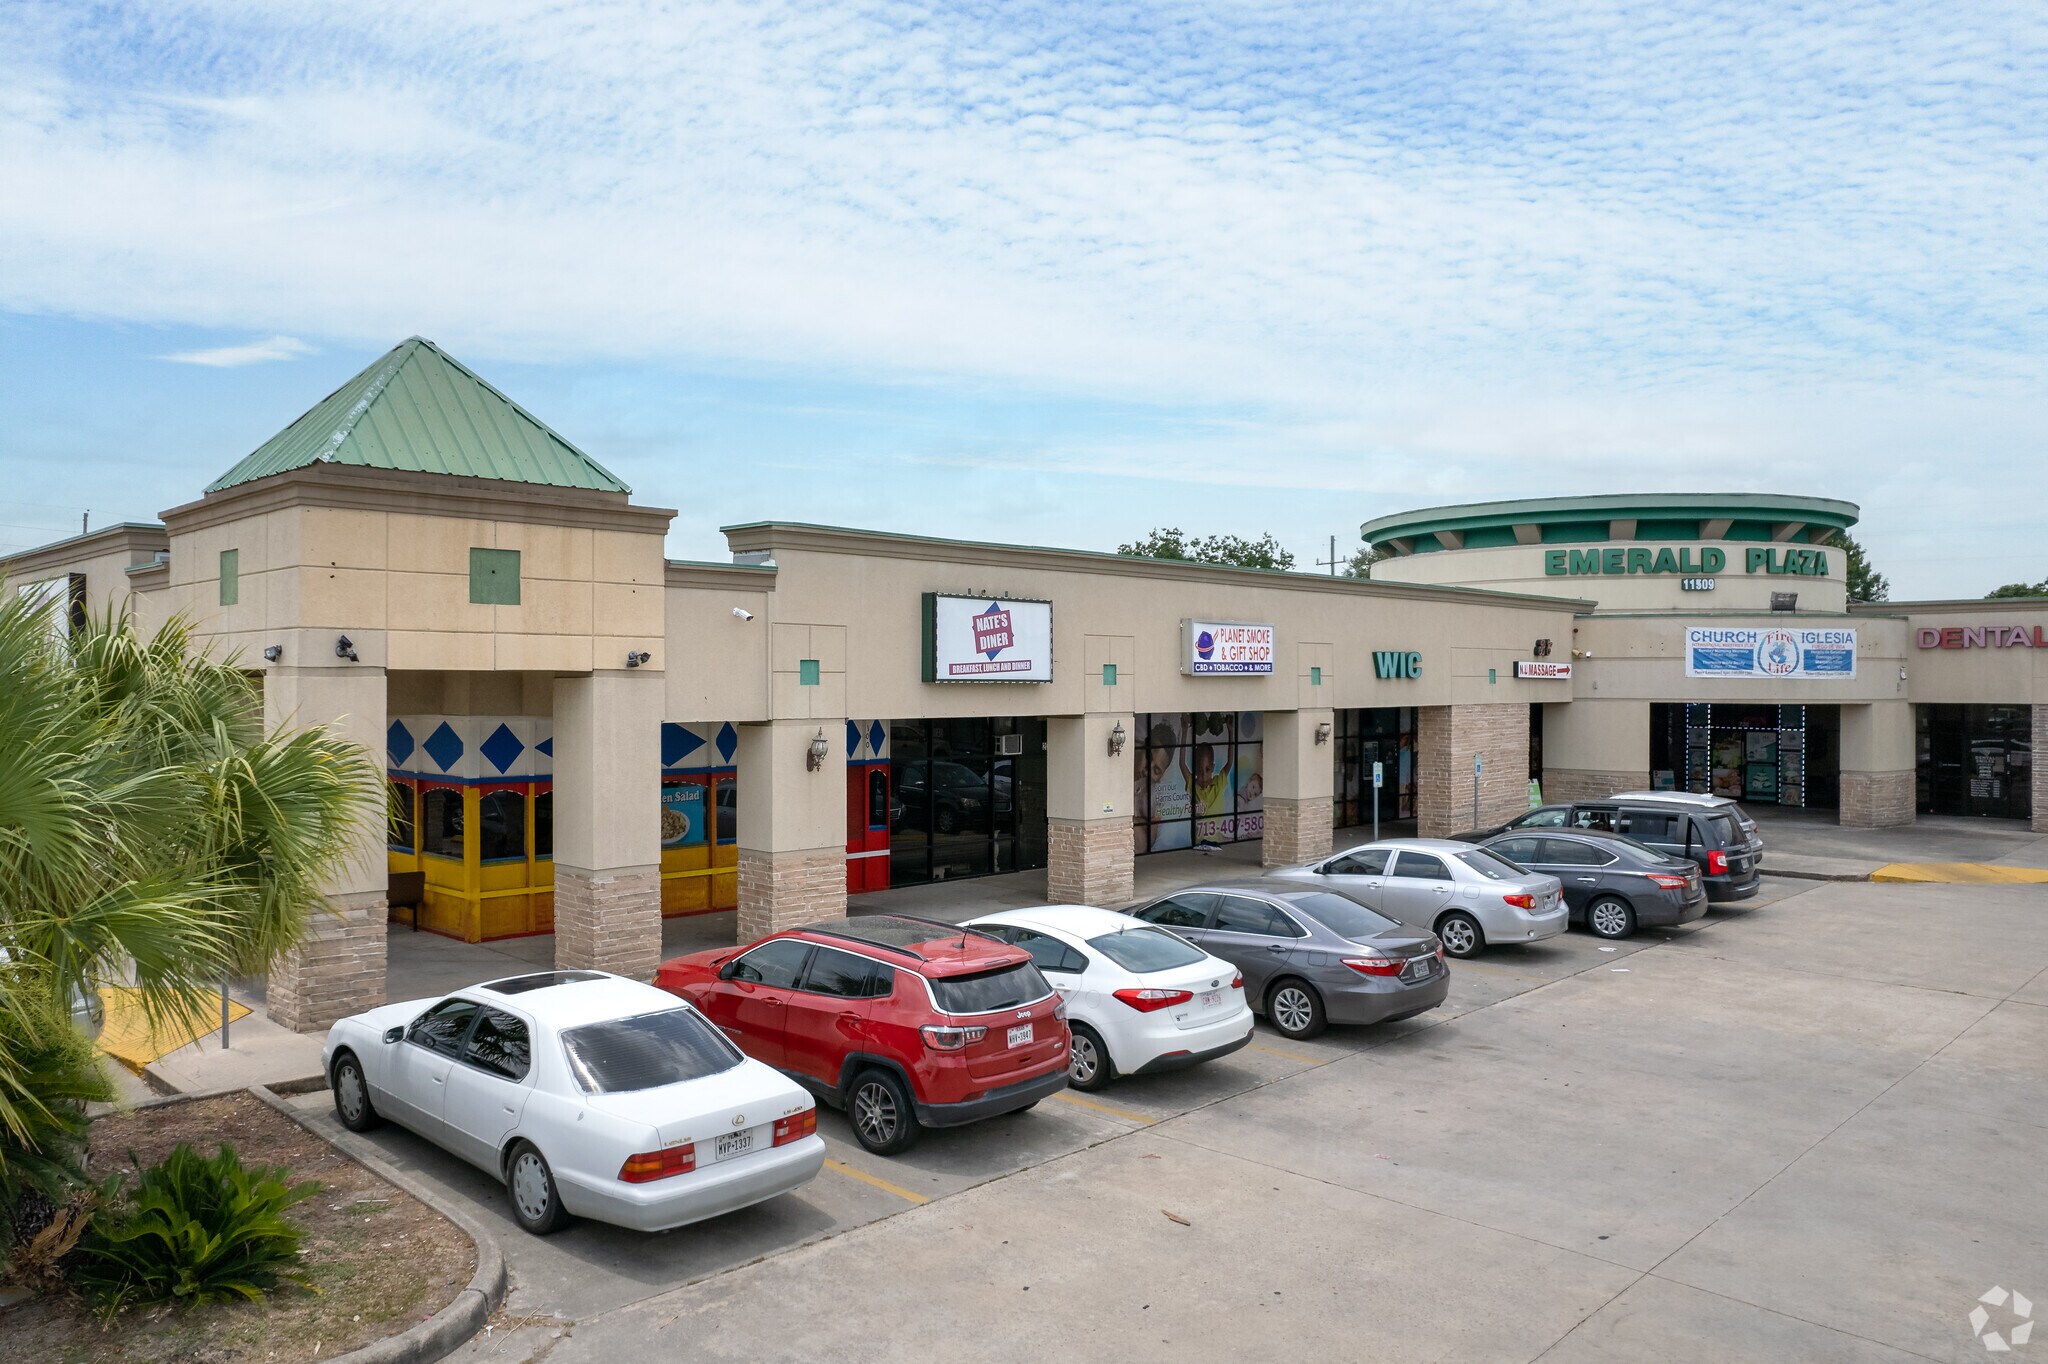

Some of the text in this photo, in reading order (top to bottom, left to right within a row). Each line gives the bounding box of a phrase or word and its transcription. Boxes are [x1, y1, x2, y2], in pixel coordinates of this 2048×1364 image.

[1545, 547, 1829, 576] EMERALD PLAZA
[976, 614, 1008, 632] NATE'S
[980, 632, 1008, 650] DINER
[1220, 628, 1270, 644] PLANET SMOKE
[1690, 631, 1756, 643] CHURCH
[1767, 630, 1792, 644] Fire
[1801, 632, 1853, 644] IGLESIA
[1918, 626, 2048, 649] DENTAL
[1222, 646, 1270, 661] & GIFT SHOP
[983, 664, 1001, 672] LUNCH
[1001, 662, 1011, 671] AND
[1012, 661, 1030, 670] DINNER
[1372, 652, 1422, 679] WIC
[1529, 664, 1557, 676] MASSAGE
[1768, 663, 1791, 674] Life
[675, 791, 699, 801] Salad
[1157, 804, 1184, 817] Healthy
[1017, 1011, 1032, 1019] Jeep
